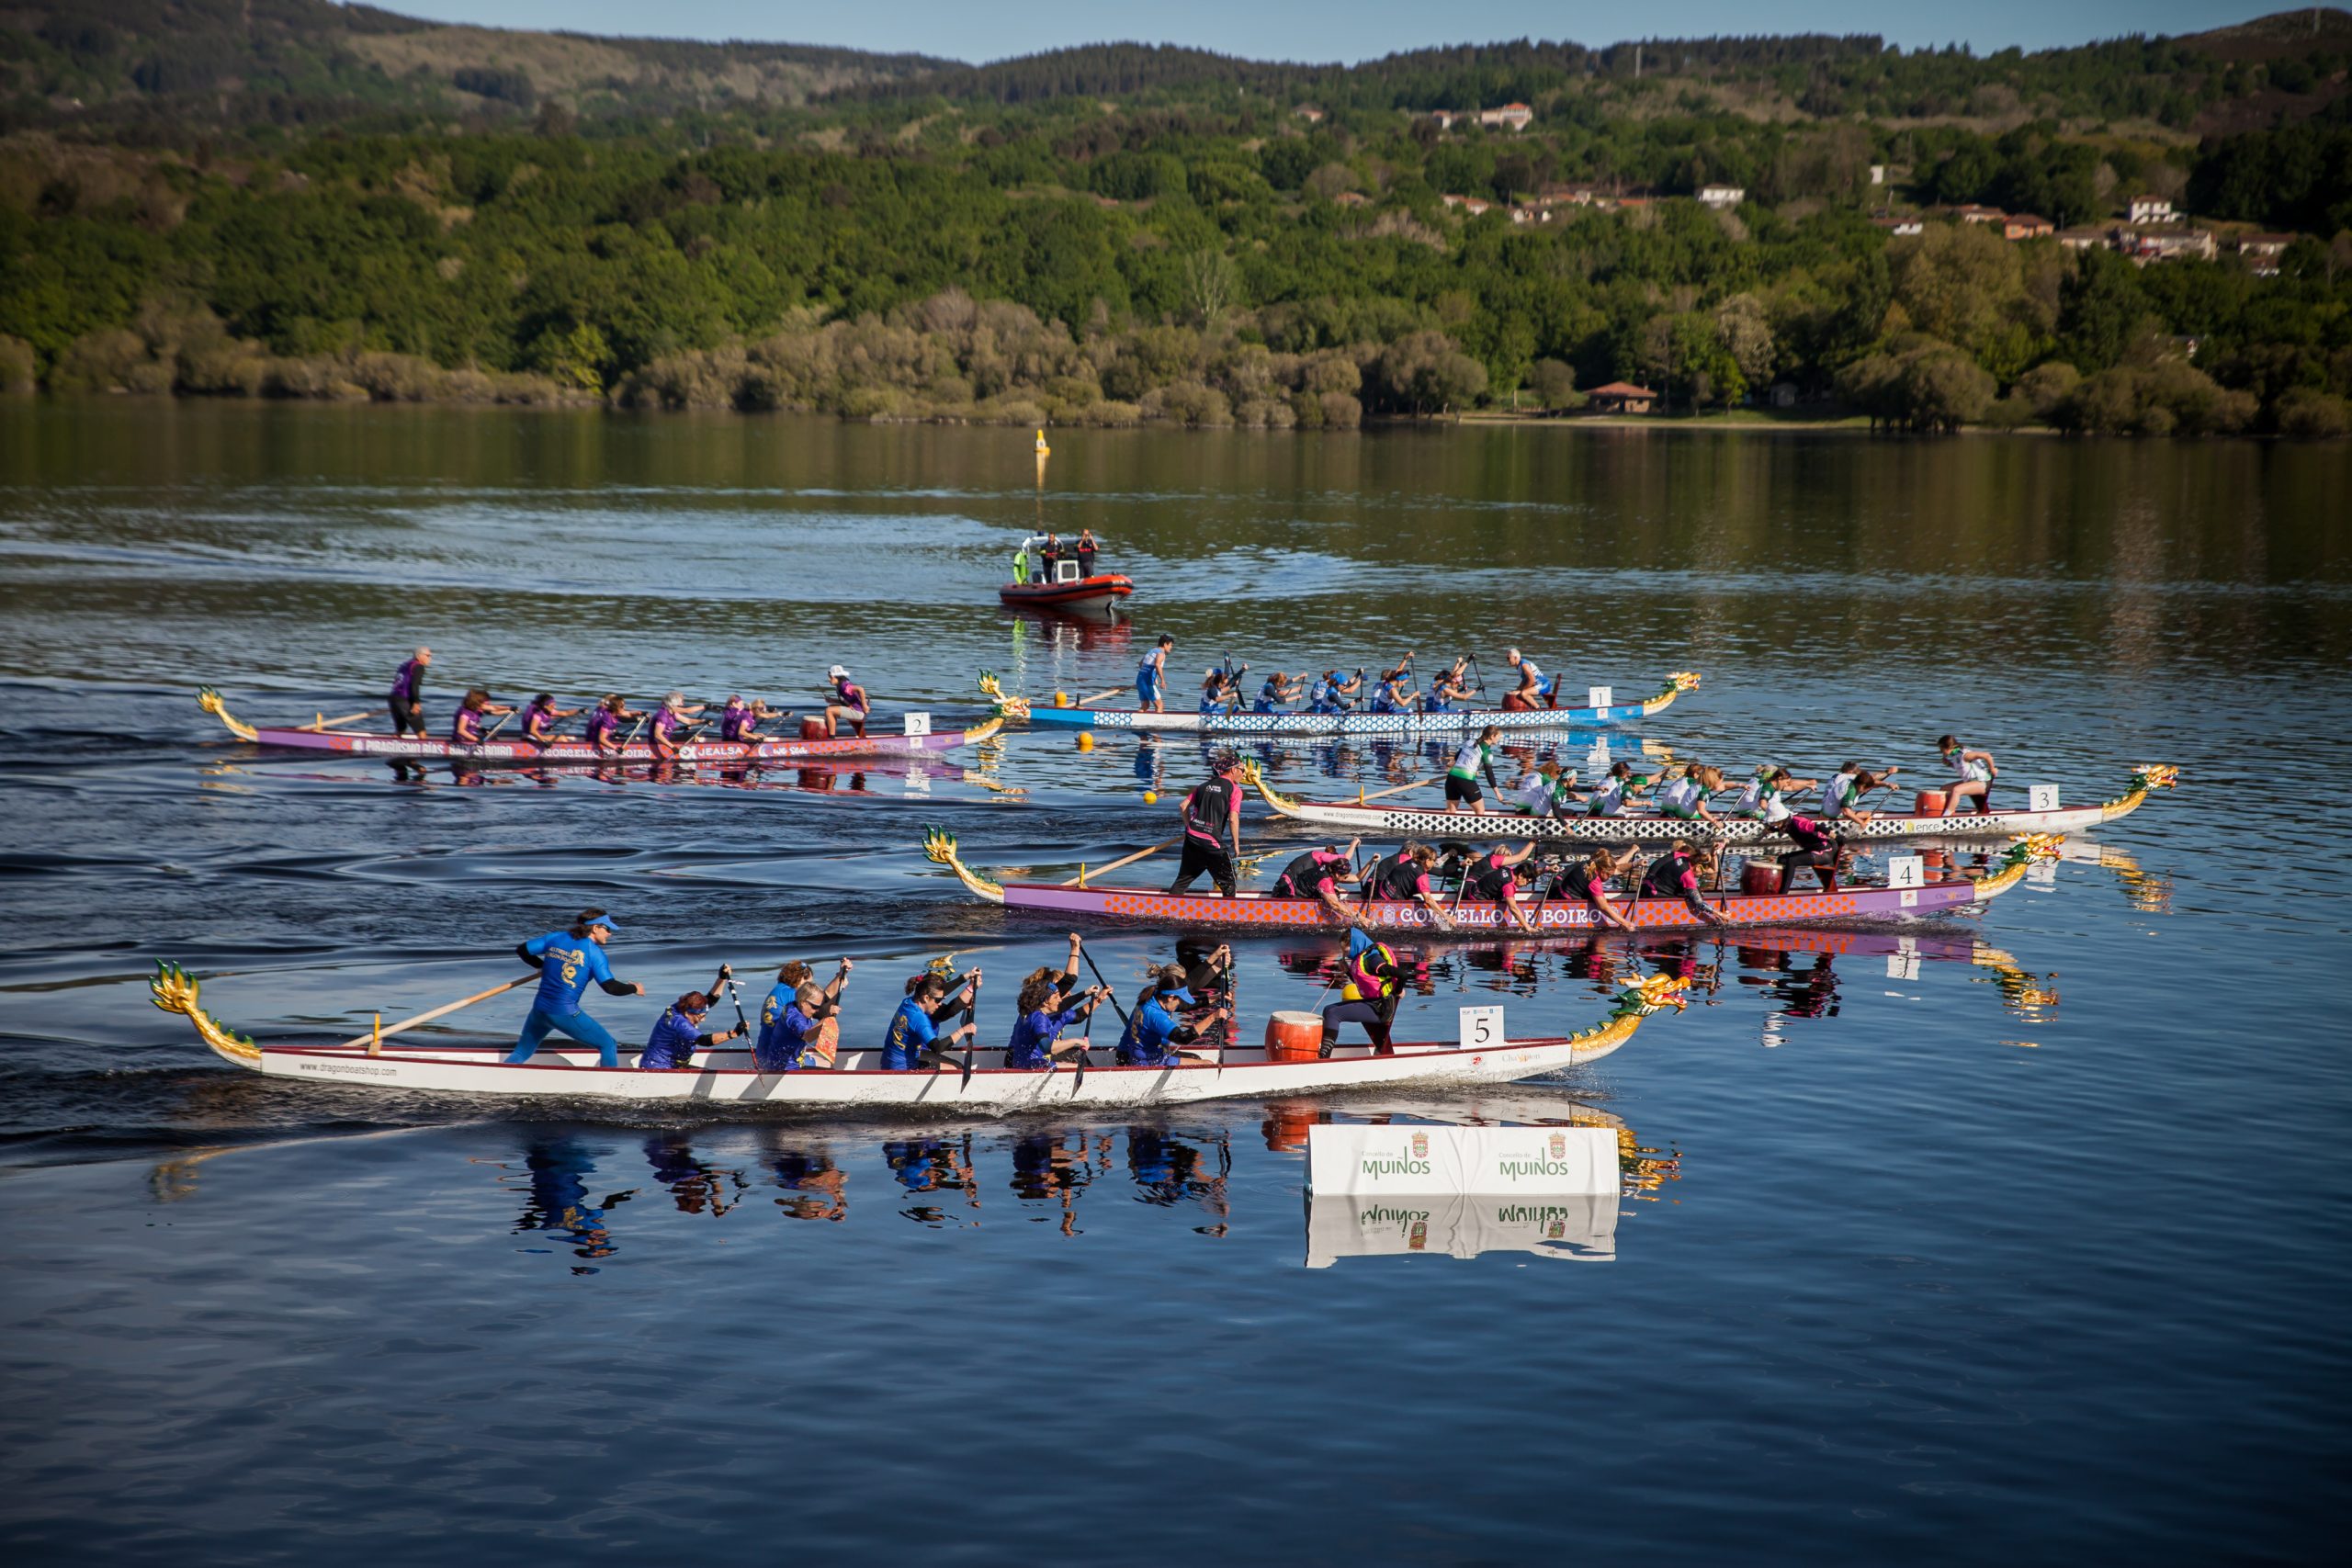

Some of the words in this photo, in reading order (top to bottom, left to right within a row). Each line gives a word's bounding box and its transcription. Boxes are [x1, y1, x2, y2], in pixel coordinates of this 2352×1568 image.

[913, 718, 922, 733] 2
[698, 746, 743, 757] JEALSA
[2040, 792, 2050, 808] 3
[1916, 823, 1939, 832] ence
[1900, 865, 1914, 884] 4
[1542, 909, 1601, 924] BOIRO
[1475, 1018, 1490, 1043] 5
[300, 1063, 397, 1077] www.dragonboatshop.com
[1363, 1145, 1430, 1180] MUIÑOS
[1499, 1147, 1568, 1181] MUIÑOS
